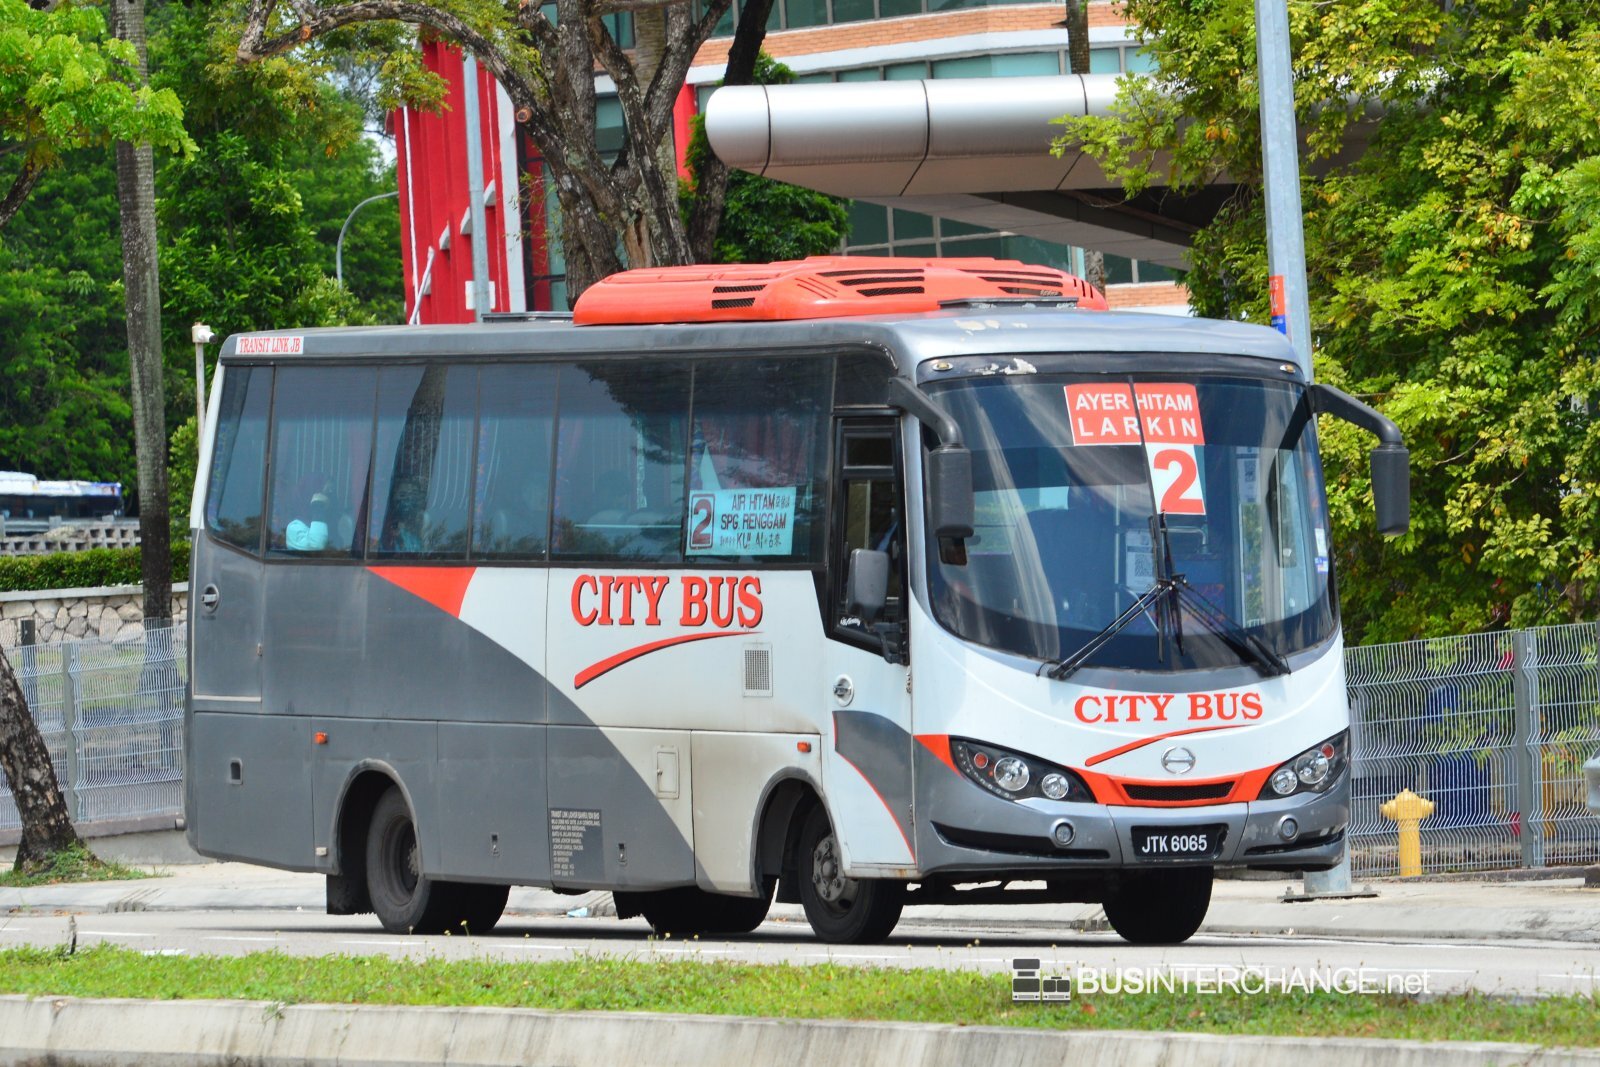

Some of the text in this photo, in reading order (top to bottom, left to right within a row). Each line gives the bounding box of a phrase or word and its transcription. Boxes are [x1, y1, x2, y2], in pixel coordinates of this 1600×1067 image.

[240, 337, 301, 353] TRANSIT LINK JB
[1075, 393, 1193, 411] AYER HITAM
[1078, 417, 1198, 437] LARKIN
[1153, 448, 1205, 514] 2
[732, 494, 746, 511] AIR
[749, 493, 776, 511] HITAM
[692, 499, 712, 545] 2
[743, 512, 787, 530] RENGGAM
[571, 573, 764, 628] CITY BUS
[1074, 692, 1263, 723] CITY BUS
[1141, 834, 1208, 853] JTK 6065
